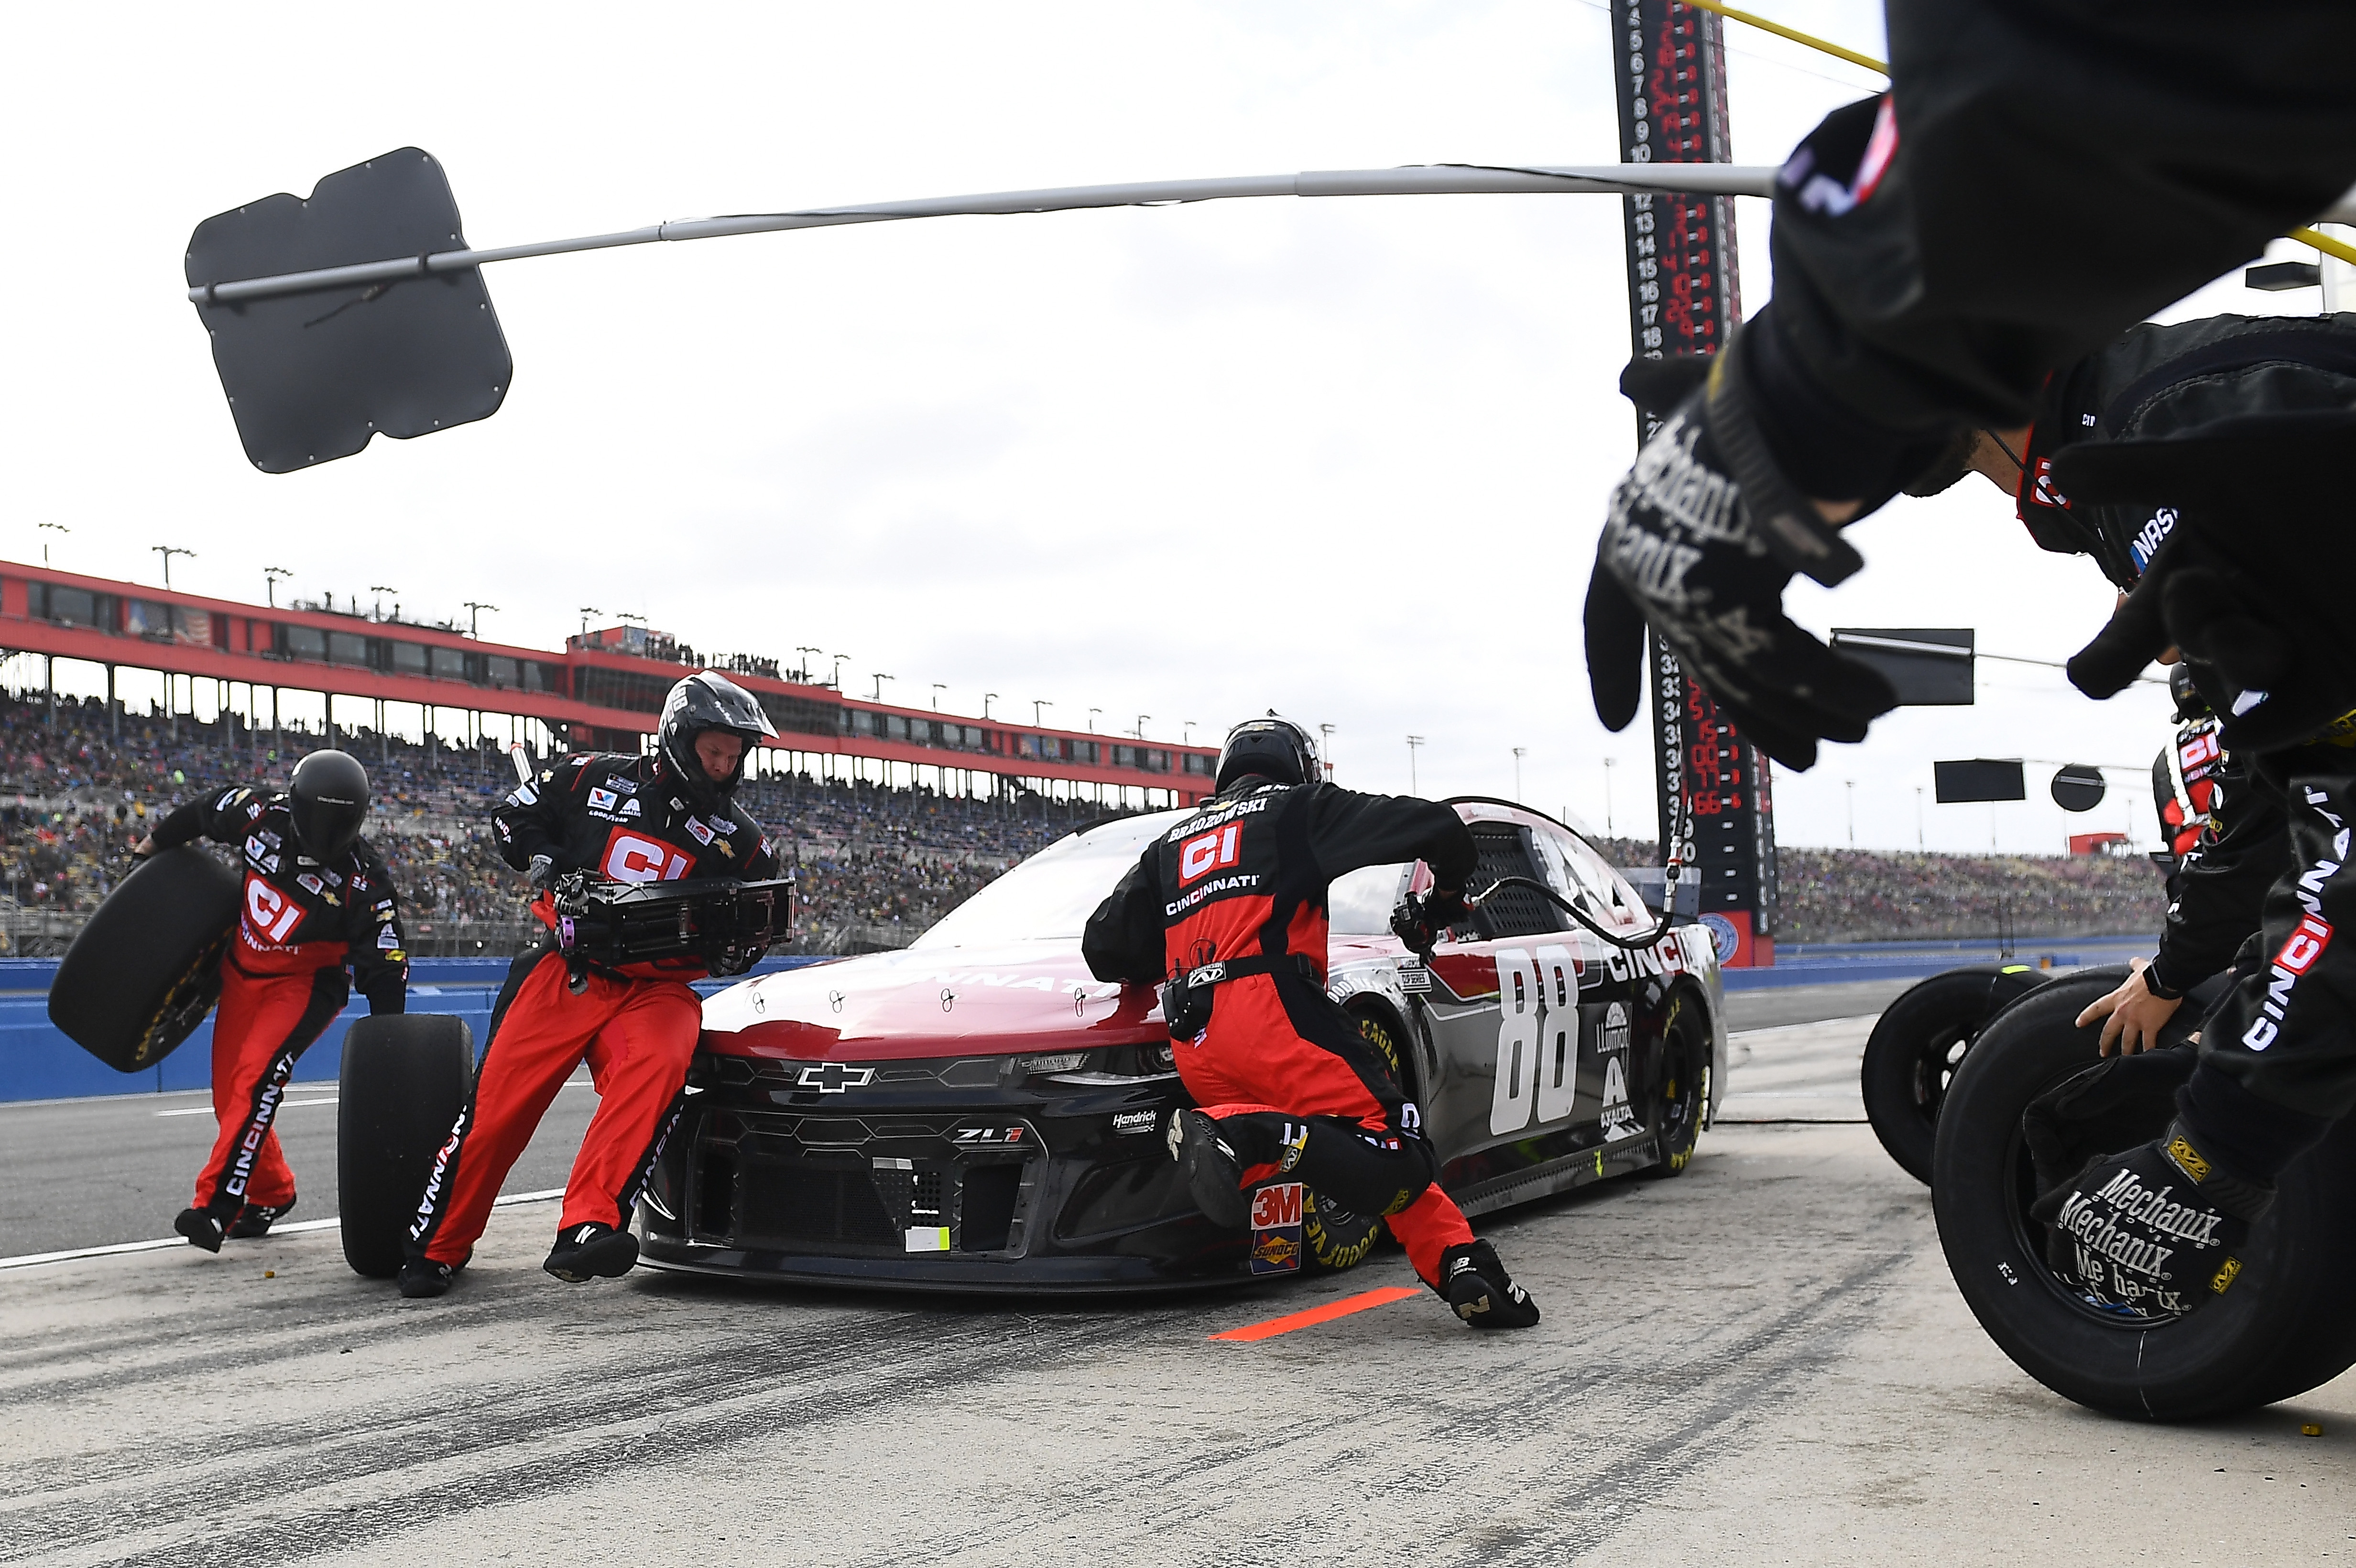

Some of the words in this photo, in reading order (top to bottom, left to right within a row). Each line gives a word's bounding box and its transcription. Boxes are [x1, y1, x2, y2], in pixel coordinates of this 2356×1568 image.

[1630, 52, 1645, 74] 6
[1631, 74, 1645, 96] 7
[1633, 97, 1648, 120] 8
[1635, 120, 1649, 143] 9
[1629, 143, 1651, 163] 10
[1634, 212, 1655, 234] 13
[1636, 234, 1657, 257] 14
[1637, 257, 1658, 280] 15
[1638, 280, 1660, 303] 16
[1639, 303, 1659, 326] 17
[1641, 326, 1663, 348] 18
[2133, 507, 2178, 565] NAS
[1694, 791, 1722, 815] 66
[608, 835, 687, 882] CI
[1182, 826, 1237, 879] CI
[1166, 874, 1259, 916] CINCINNATI
[248, 879, 300, 942] CI
[1489, 945, 1580, 1137] 88
[1113, 1110, 1157, 1128] Hendrick
[952, 1127, 1025, 1143] ZL1
[1253, 1185, 1301, 1227] 3M
[2097, 1168, 2222, 1244] Mechanix
[2059, 1190, 2174, 1280] Mechanix
[1253, 1243, 1299, 1259] SUNOCO
